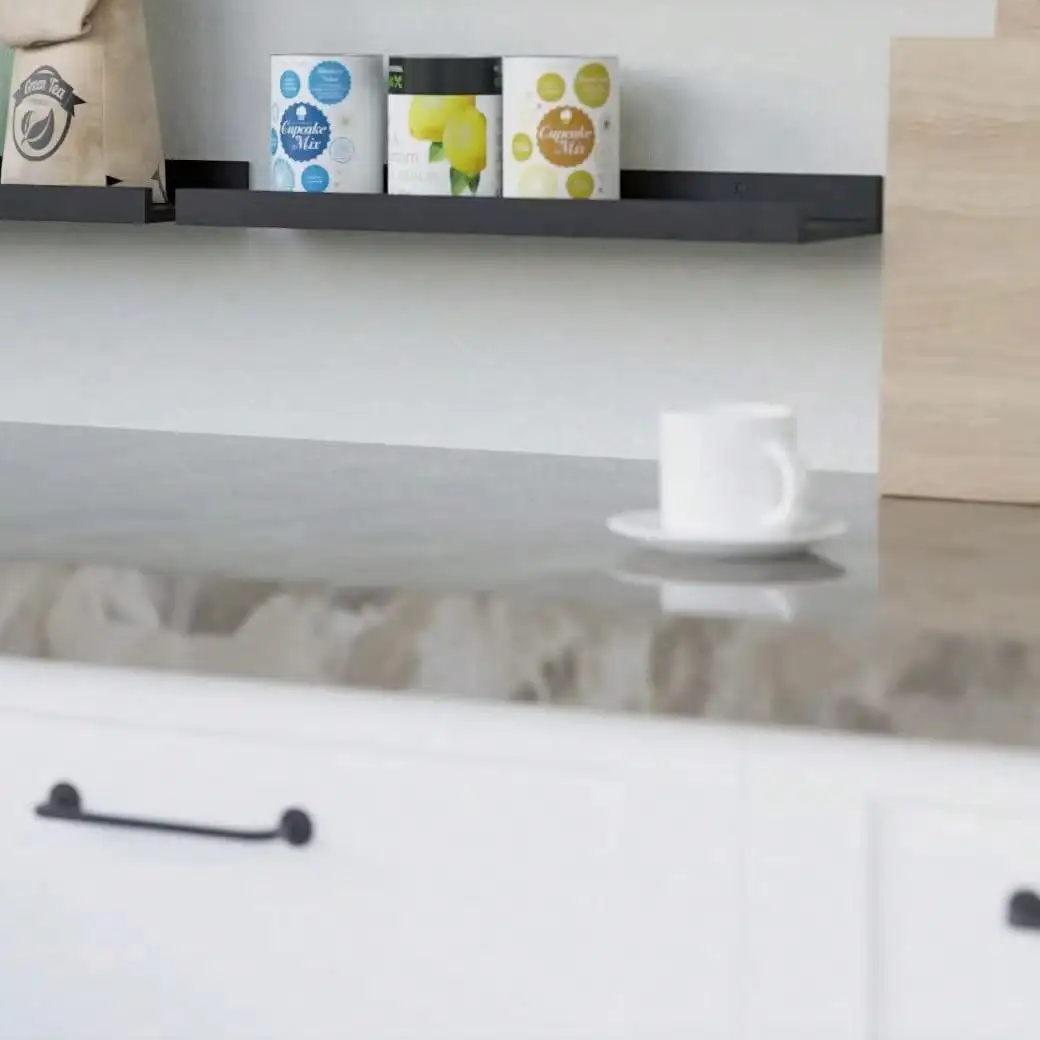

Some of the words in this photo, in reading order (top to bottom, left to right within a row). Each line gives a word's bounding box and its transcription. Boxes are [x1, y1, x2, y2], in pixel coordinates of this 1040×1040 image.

[281, 119, 328, 139] Cupcake
[537, 125, 593, 141] Cupcake
[294, 135, 322, 151] Mix
